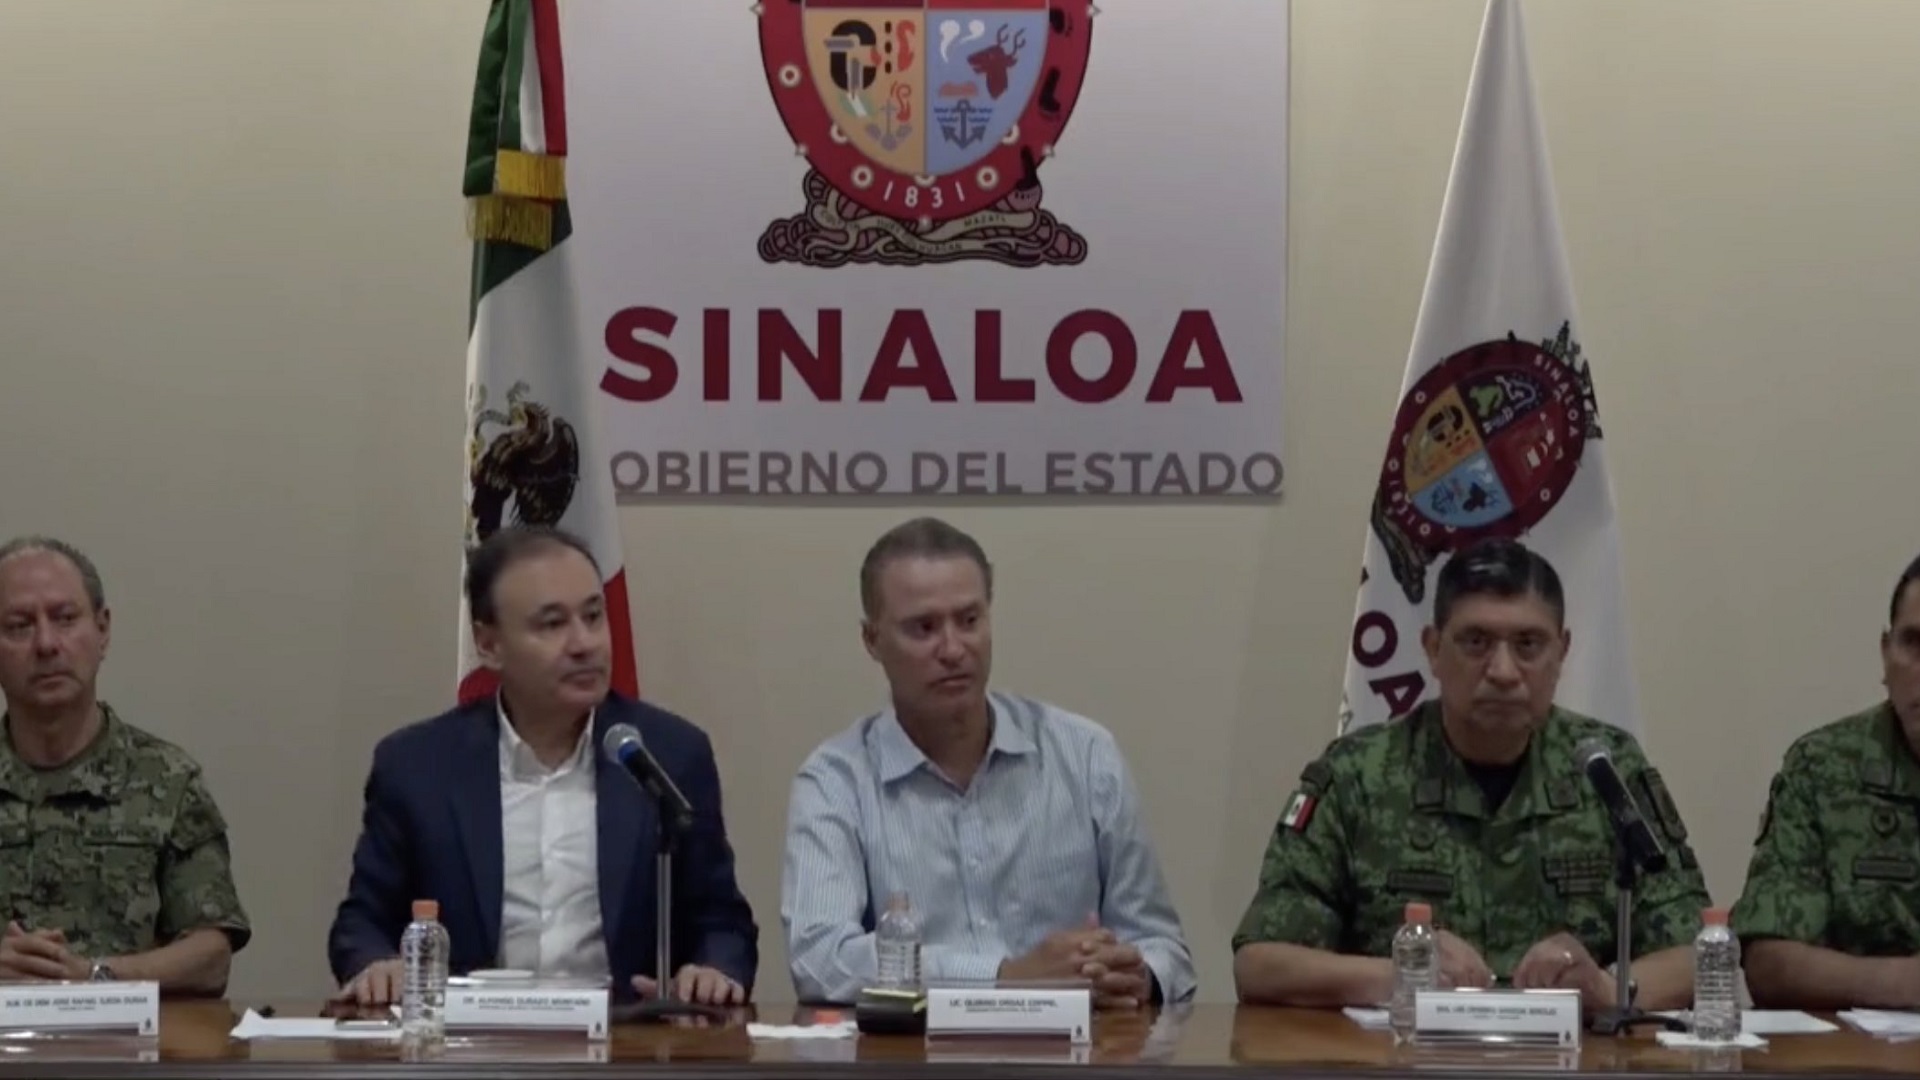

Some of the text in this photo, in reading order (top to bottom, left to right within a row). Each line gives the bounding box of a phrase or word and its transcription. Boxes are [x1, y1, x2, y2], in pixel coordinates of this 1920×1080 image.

[884, 181, 964, 208] 1831
[600, 306, 1243, 403] SINALOA
[1534, 354, 1579, 437] SINALOA
[609, 451, 1284, 494] OBIERNO DEL ESTADO
[1353, 566, 1425, 721] OA
